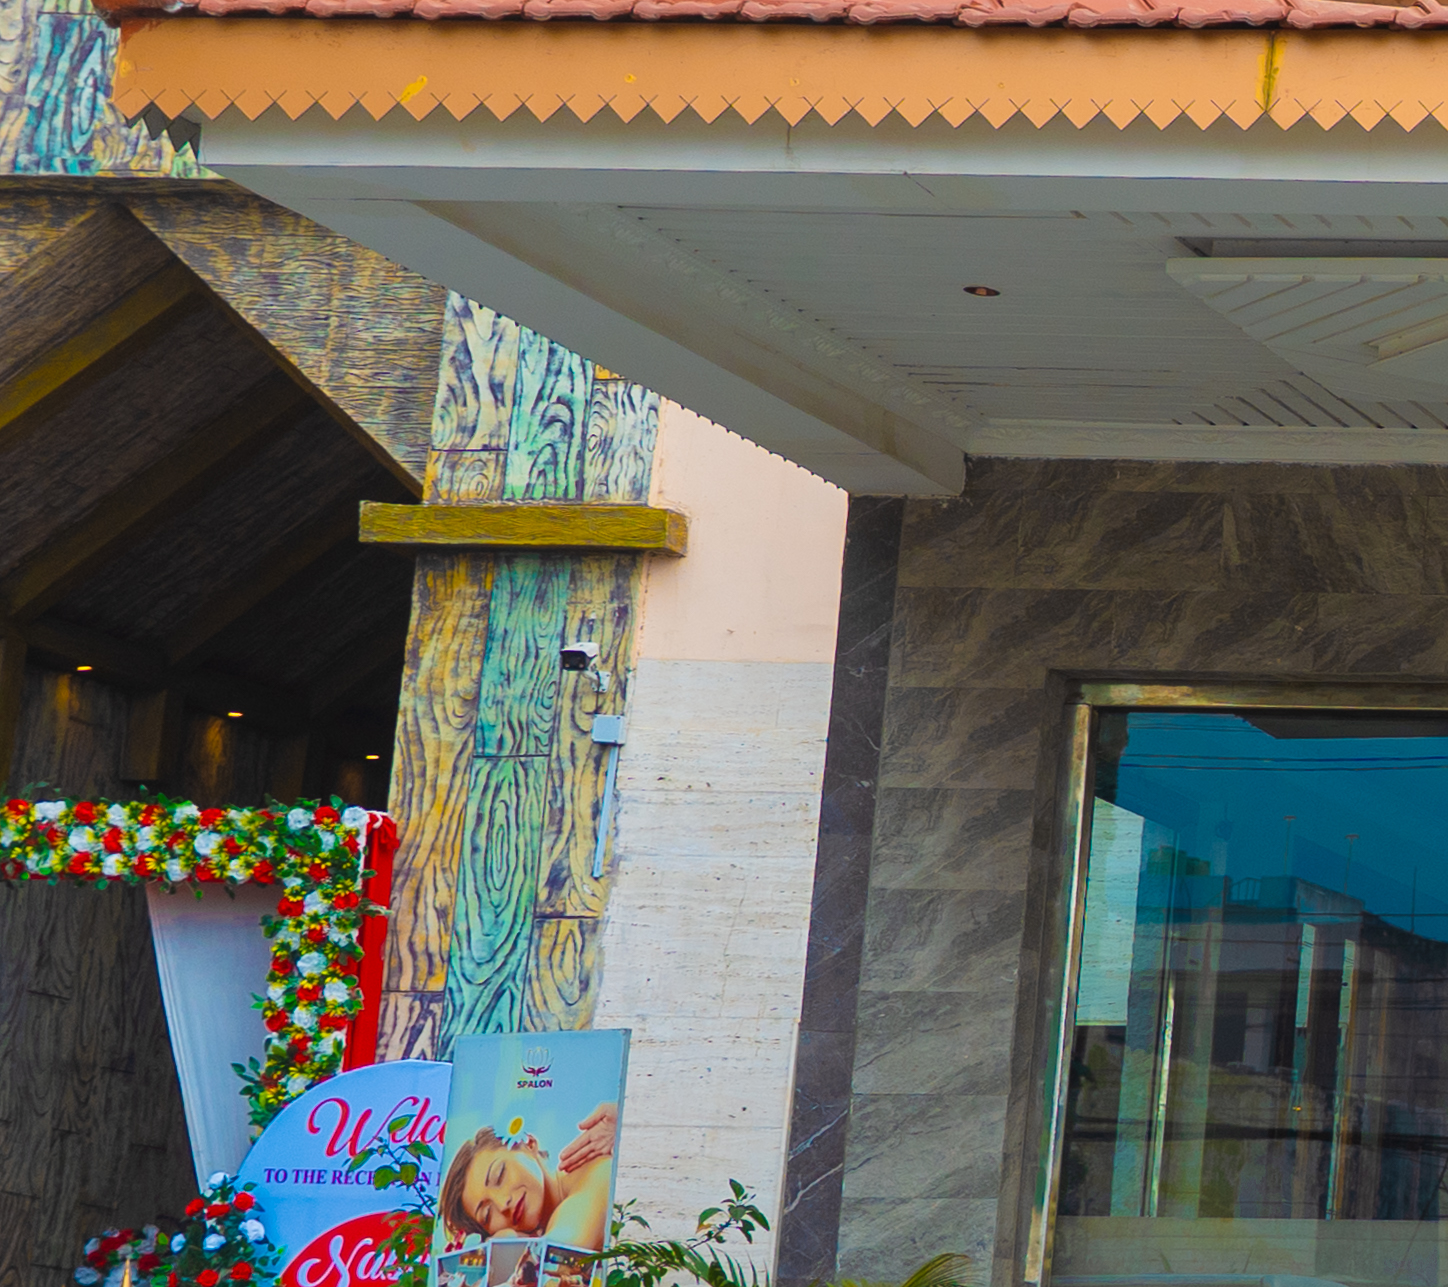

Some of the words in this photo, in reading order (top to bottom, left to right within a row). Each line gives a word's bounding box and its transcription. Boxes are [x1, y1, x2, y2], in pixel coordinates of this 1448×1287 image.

[517, 1079, 553, 1089] SPALON
[264, 1168, 288, 1184] TO
[292, 1168, 327, 1184] THE
